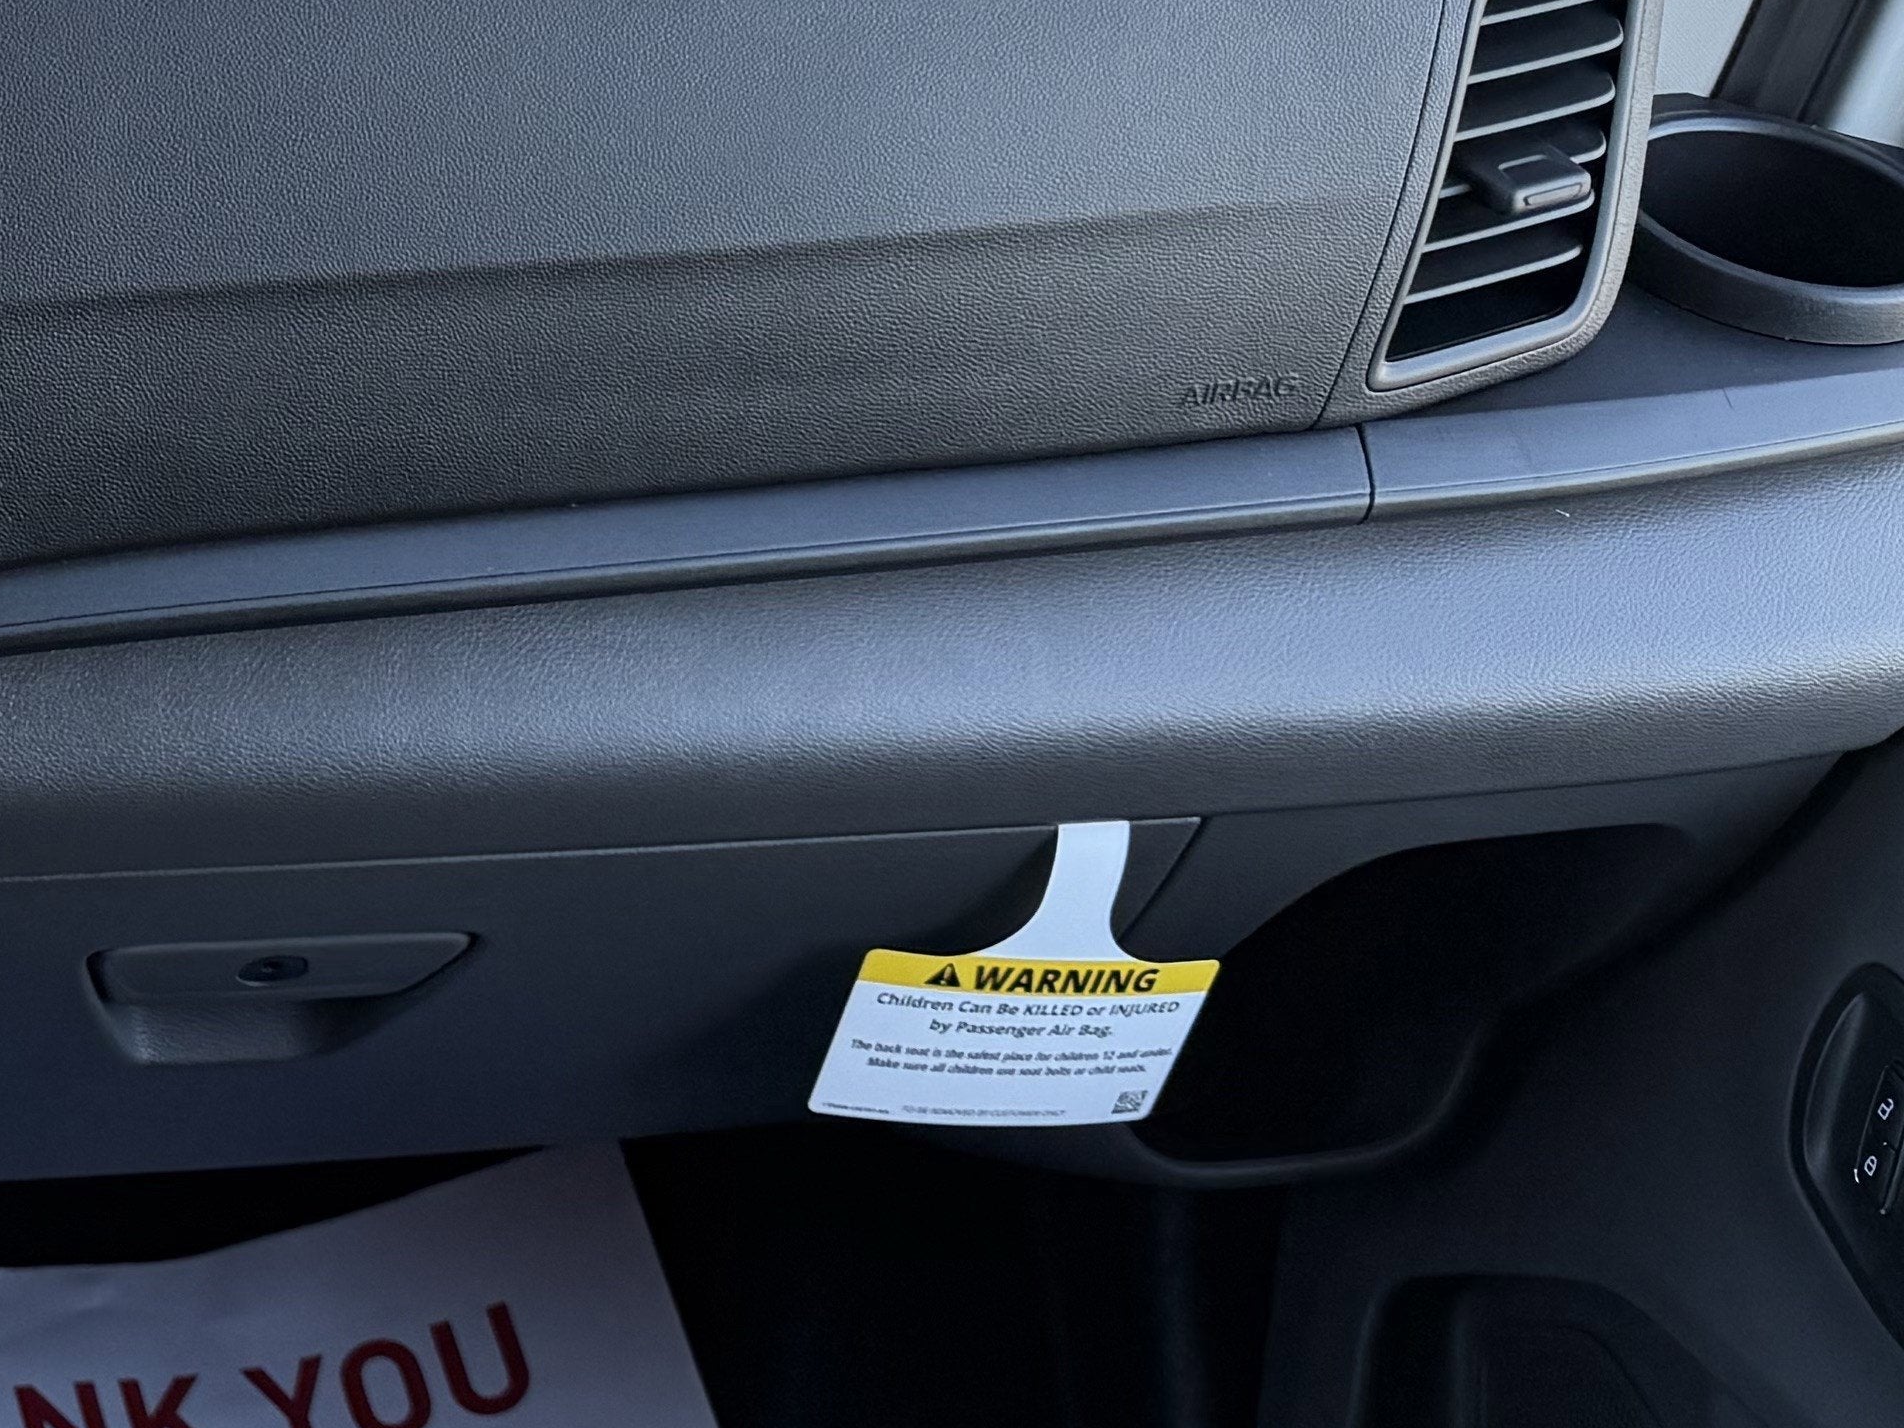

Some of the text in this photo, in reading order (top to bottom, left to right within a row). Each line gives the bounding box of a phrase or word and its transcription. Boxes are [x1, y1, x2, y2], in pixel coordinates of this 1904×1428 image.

[973, 964, 1160, 994] WARNING
[876, 991, 1180, 1018] Children Can Be KILLED or INJURED
[929, 1018, 1113, 1038] by Passenger Air Bag.
[850, 1038, 872, 1052] The
[874, 1041, 902, 1055] back
[945, 1048, 965, 1059] the
[867, 1057, 901, 1069] Make
[948, 1063, 994, 1075] children
